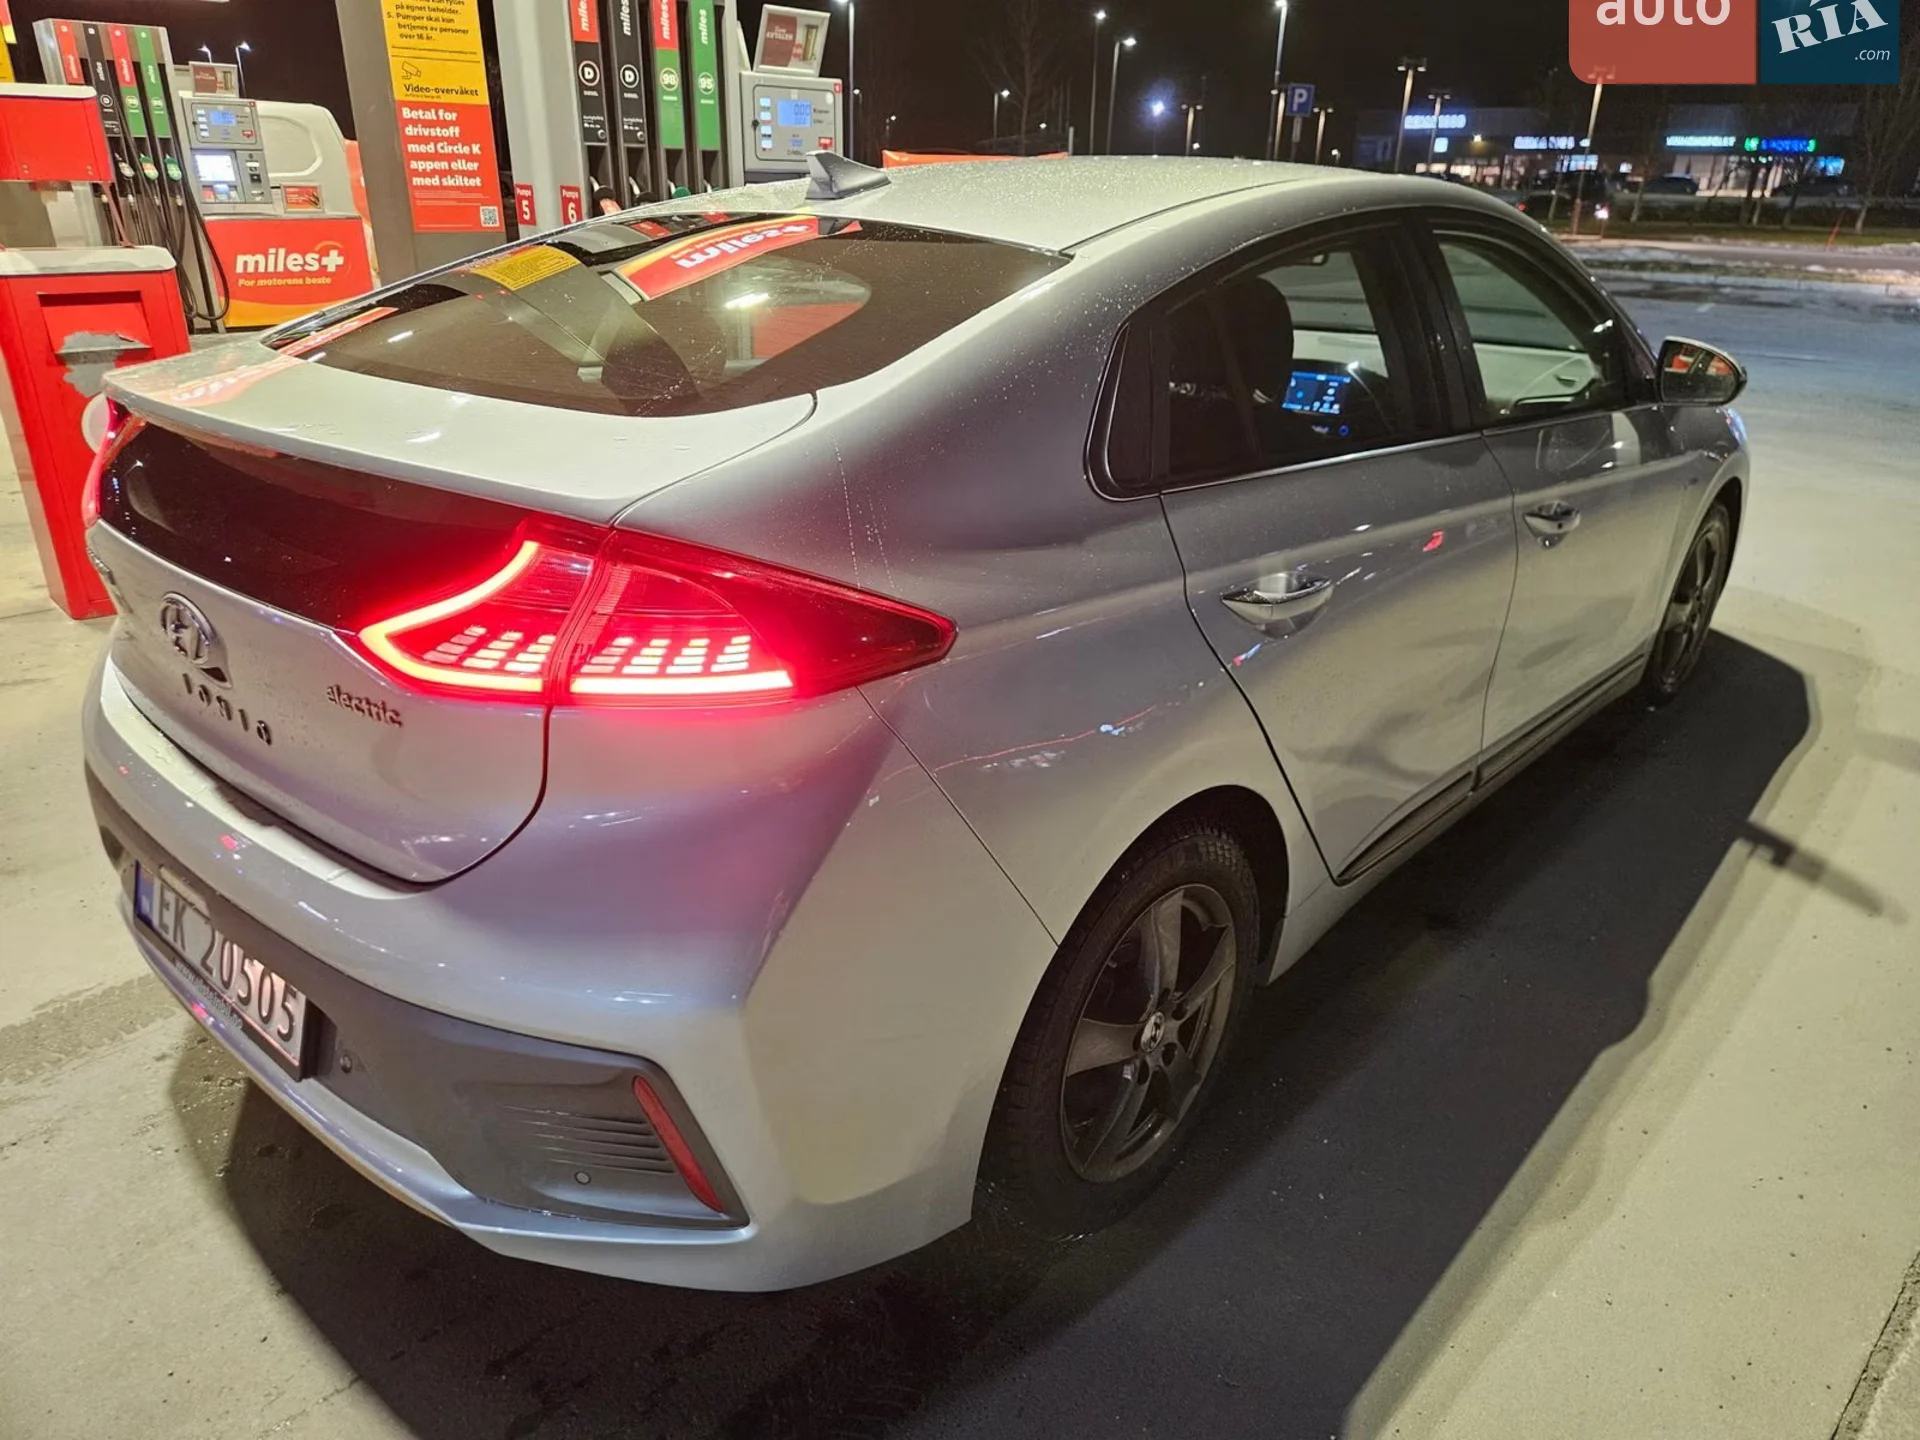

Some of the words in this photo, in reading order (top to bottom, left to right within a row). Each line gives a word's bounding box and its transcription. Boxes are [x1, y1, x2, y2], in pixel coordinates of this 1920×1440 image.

[396, 13, 425, 22] Pumper
[397, 22, 428, 32] betjenes
[439, 27, 469, 35] personer
[698, 9, 709, 45] miles
[583, 66, 595, 80] D
[624, 70, 635, 83] D
[662, 73, 676, 86] 98
[699, 77, 713, 90] 95
[403, 84, 480, 97] Video-overvåket
[1293, 89, 1307, 111] P
[401, 107, 437, 121] Betal
[438, 109, 458, 121] for
[404, 124, 460, 138] drivstoff
[407, 142, 435, 153] med
[436, 142, 470, 155] Circle
[471, 143, 482, 155] K
[410, 160, 449, 172] appen
[450, 160, 479, 171] eller
[412, 175, 440, 186] med
[441, 175, 482, 187] skiltet
[521, 199, 531, 221] 5
[568, 202, 577, 224] 6
[238, 278, 256, 287] For
[257, 276, 303, 286] motorens
[305, 276, 332, 285] beste
[326, 684, 403, 728] electric
[158, 882, 187, 952] EK
[201, 918, 297, 1043] 20505
